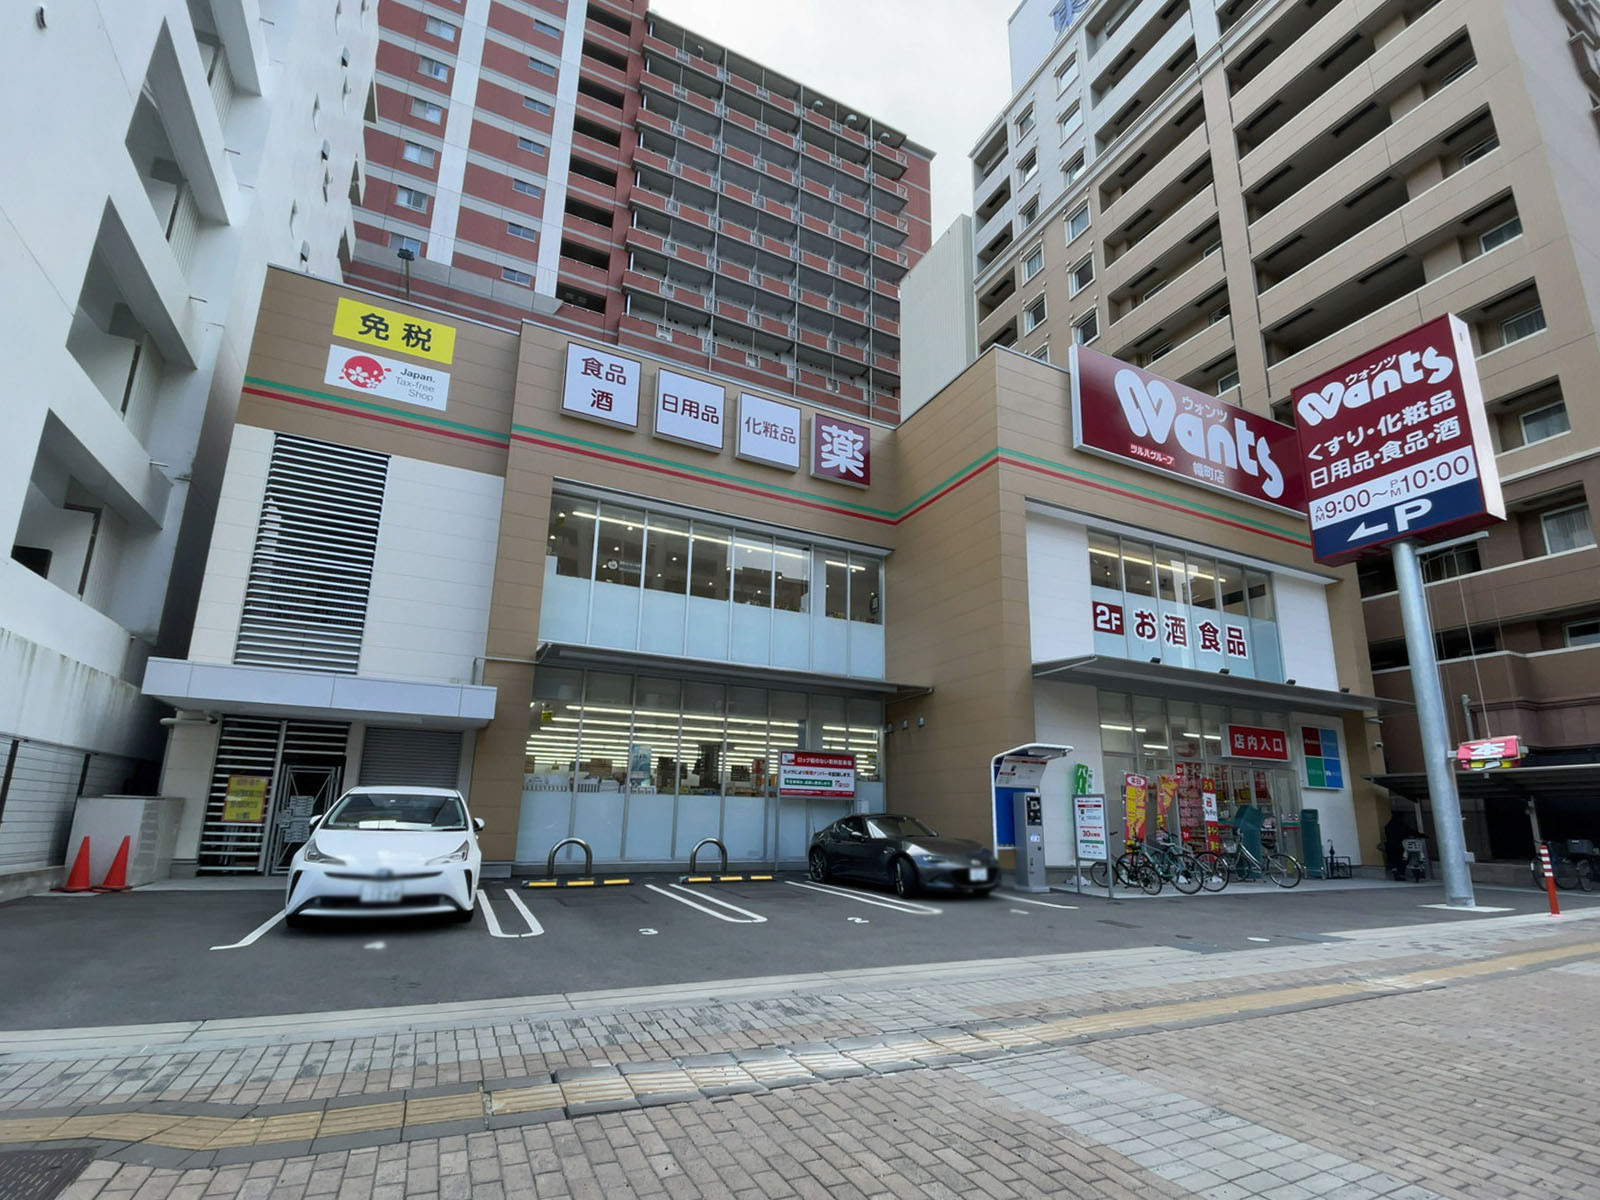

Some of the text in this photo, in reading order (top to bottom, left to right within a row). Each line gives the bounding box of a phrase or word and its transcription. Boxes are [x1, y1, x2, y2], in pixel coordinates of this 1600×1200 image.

[358, 313, 432, 352] 免税
[400, 368, 436, 383] Japan.
[581, 357, 626, 385] 食品
[1345, 354, 1397, 385] ウォンツ
[395, 376, 435, 393] Tax-free
[408, 388, 434, 401] Shop
[1297, 346, 1454, 426] Wants
[591, 388, 614, 412] 酒
[662, 393, 719, 425] 日用品
[1182, 396, 1228, 423] ウォンツ
[745, 416, 796, 445] 化粧品
[1114, 368, 1284, 499] Wants
[821, 425, 864, 478] 薬
[1130, 444, 1175, 466] ツルハグループ
[1394, 498, 1432, 533] P
[1096, 605, 1121, 632] 2F
[1233, 733, 1283, 752] 店内入口
